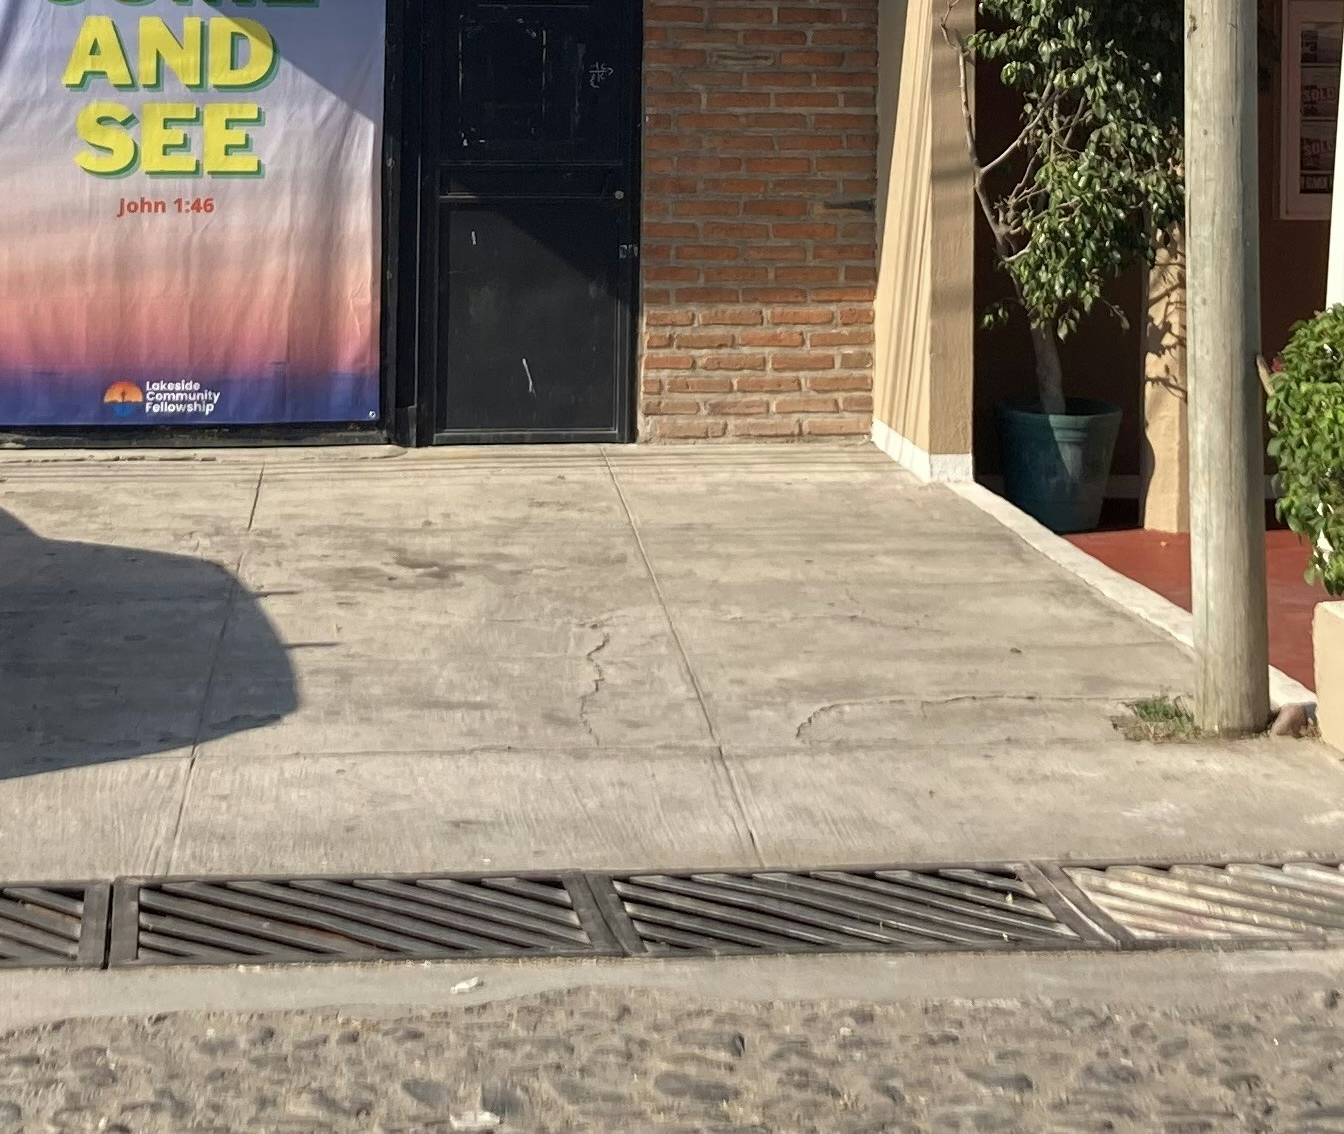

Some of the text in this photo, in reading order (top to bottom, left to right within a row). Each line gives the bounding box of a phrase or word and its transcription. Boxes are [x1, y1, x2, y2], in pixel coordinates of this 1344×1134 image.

[61, 15, 279, 92] AND
[72, 101, 266, 179] SEE
[116, 197, 215, 217] John 1:46
[145, 379, 201, 392] Lakeside
[145, 389, 221, 404] Community
[145, 400, 215, 415] Fellowship
